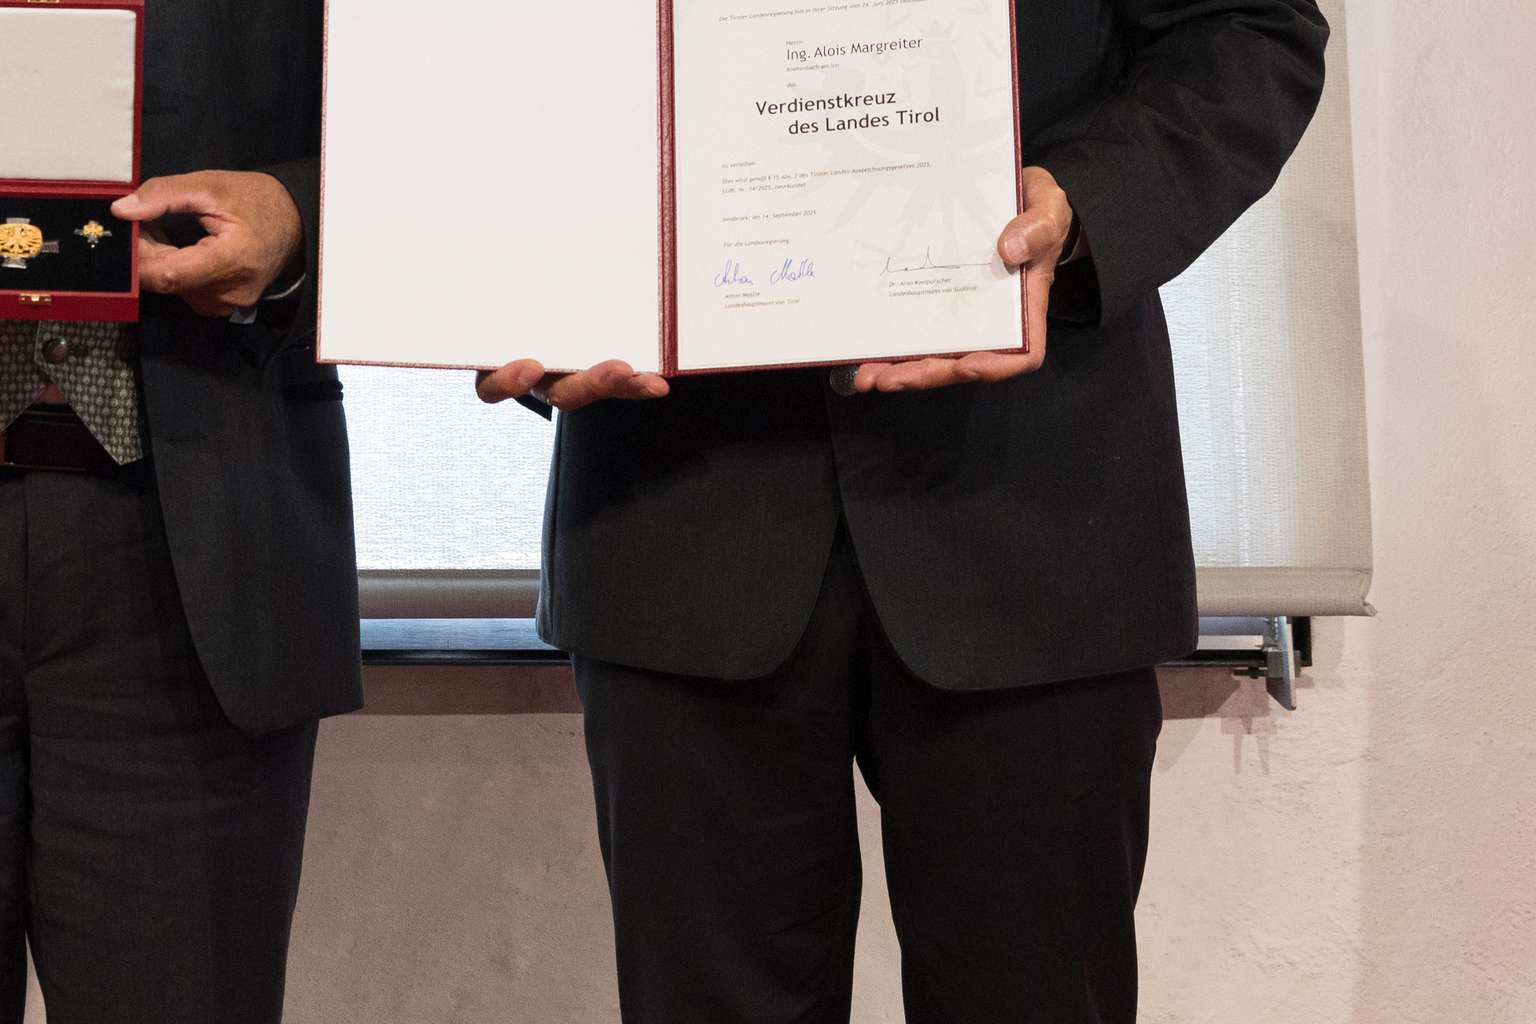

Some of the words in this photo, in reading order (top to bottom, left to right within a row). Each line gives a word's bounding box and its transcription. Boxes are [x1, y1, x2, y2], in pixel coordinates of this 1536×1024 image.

[787, 49, 810, 62] Ing.
[814, 45, 846, 58] Alois
[850, 38, 923, 55] Margreiter
[756, 92, 896, 116] Verdienstkreuz
[788, 120, 819, 135] des
[825, 114, 889, 132] Landes
[896, 107, 940, 125] Tirol
